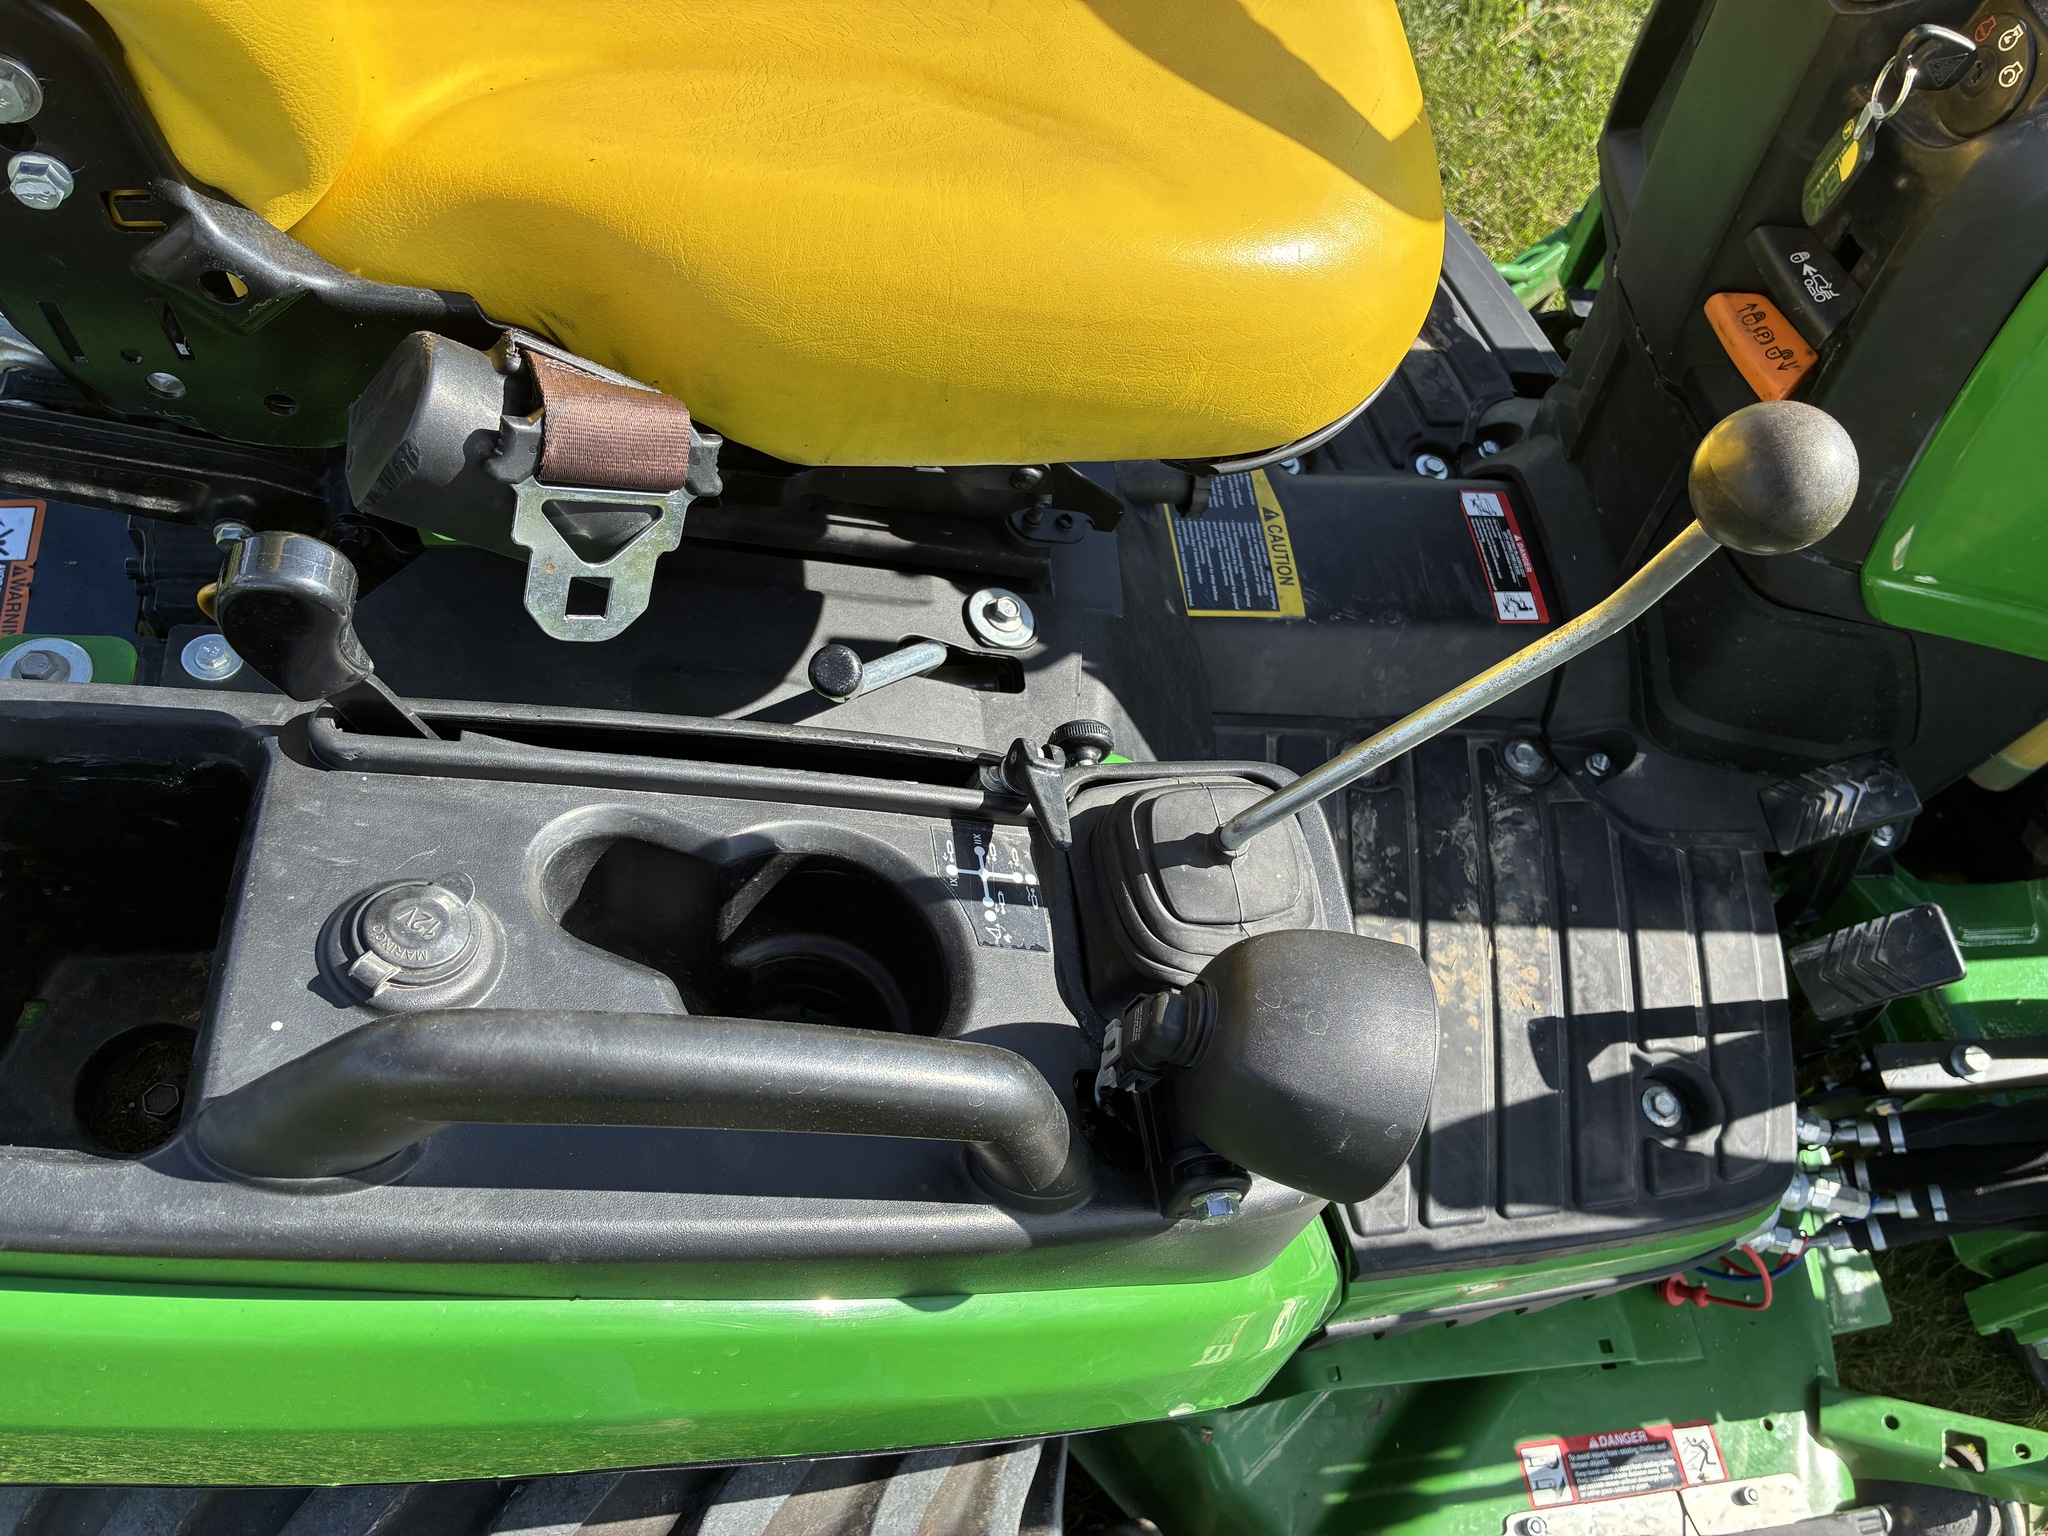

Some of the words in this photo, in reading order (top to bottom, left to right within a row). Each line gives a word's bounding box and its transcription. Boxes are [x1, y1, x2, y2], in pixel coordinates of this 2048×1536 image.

[1267, 524, 1295, 586] CAUTION
[1516, 541, 1533, 573] DANGER
[1, 577, 26, 634] WARNIN
[394, 906, 440, 939] 12V
[372, 924, 428, 961] MARINCO
[1598, 1430, 1648, 1446] DANGER
